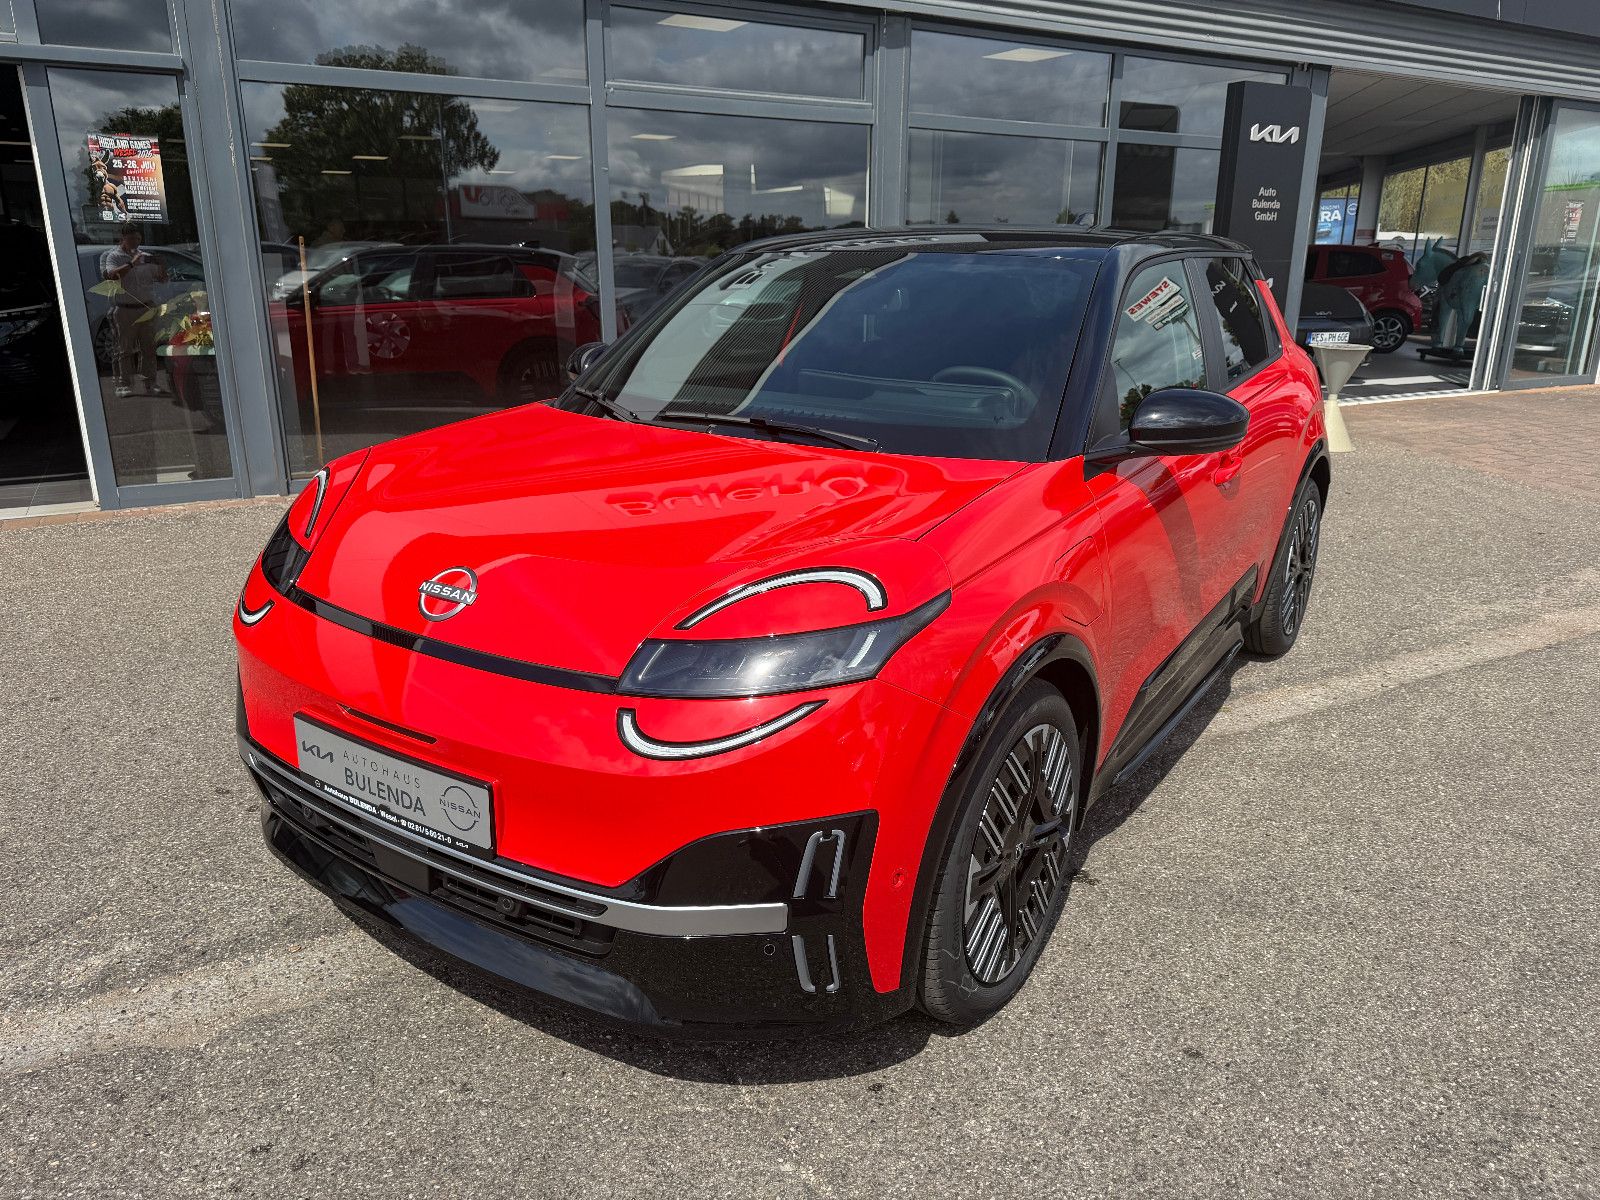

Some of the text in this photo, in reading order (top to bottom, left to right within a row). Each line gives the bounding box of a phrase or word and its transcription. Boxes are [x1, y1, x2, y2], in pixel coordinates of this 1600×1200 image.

[99, 136, 152, 150] HIGHLAND GAMES
[1250, 122, 1300, 144] KIA
[112, 159, 155, 169] 25.-26. JULI
[1258, 187, 1277, 197] Auto
[1252, 199, 1281, 209] Bulenda
[1254, 211, 1278, 222] GmbH
[1318, 209, 1342, 222] RA
[419, 581, 475, 603] NISSAN
[302, 740, 334, 763] KIA
[343, 750, 421, 789] AUTOHAUS
[324, 784, 349, 802] Autohaus
[349, 795, 377, 815] BULENDA
[344, 767, 426, 817] BULENDA
[439, 798, 481, 819] NISSAN
